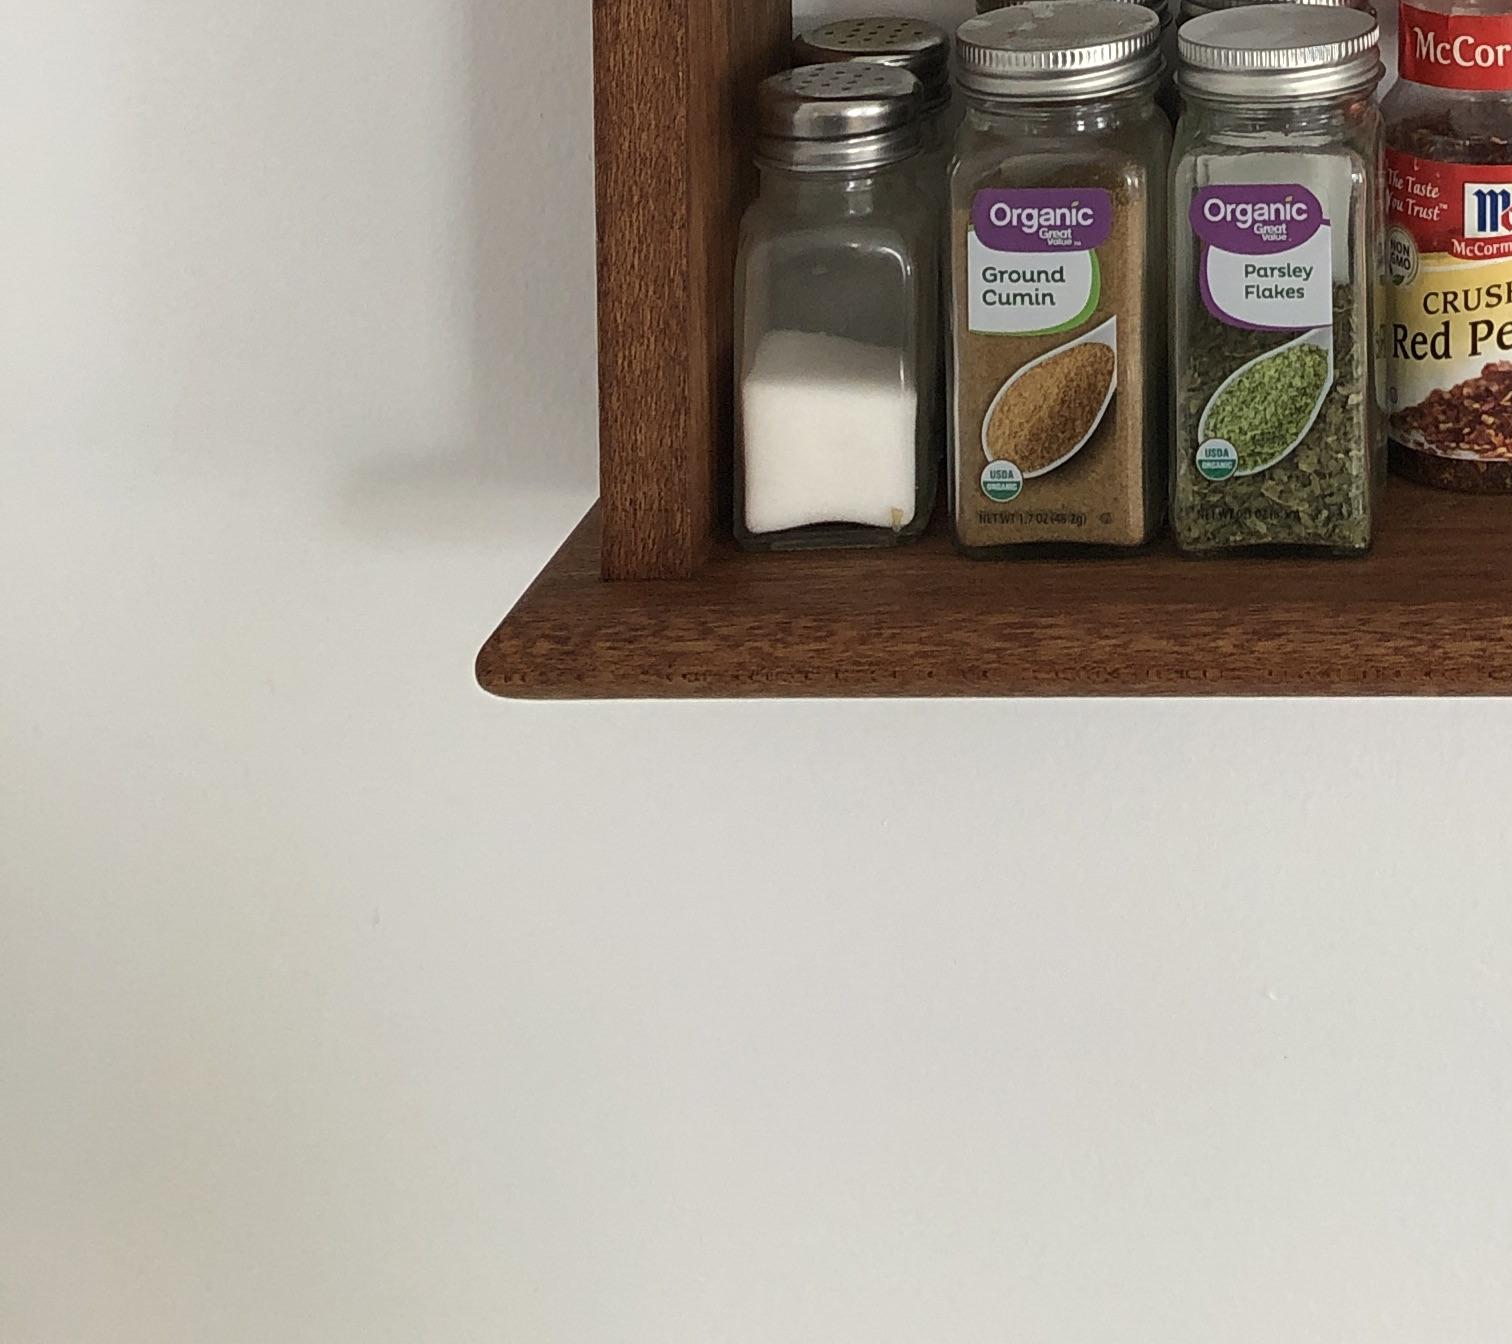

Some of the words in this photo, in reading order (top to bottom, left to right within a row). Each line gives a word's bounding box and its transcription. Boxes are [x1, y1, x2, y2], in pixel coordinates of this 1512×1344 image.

[1406, 176, 1439, 198] Taste
[990, 201, 1094, 233] Organic
[1204, 196, 1308, 229] Organic
[1039, 228, 1072, 238] Great
[1254, 223, 1287, 234] Great
[1262, 233, 1287, 241] Value
[982, 266, 1065, 283] Ground
[1245, 263, 1313, 281] Parsley
[982, 288, 1056, 306] Cumin
[1245, 284, 1304, 299] Flakes
[1393, 321, 1452, 360] Red
[1205, 448, 1229, 457] USDA
[990, 470, 1014, 479] USDA
